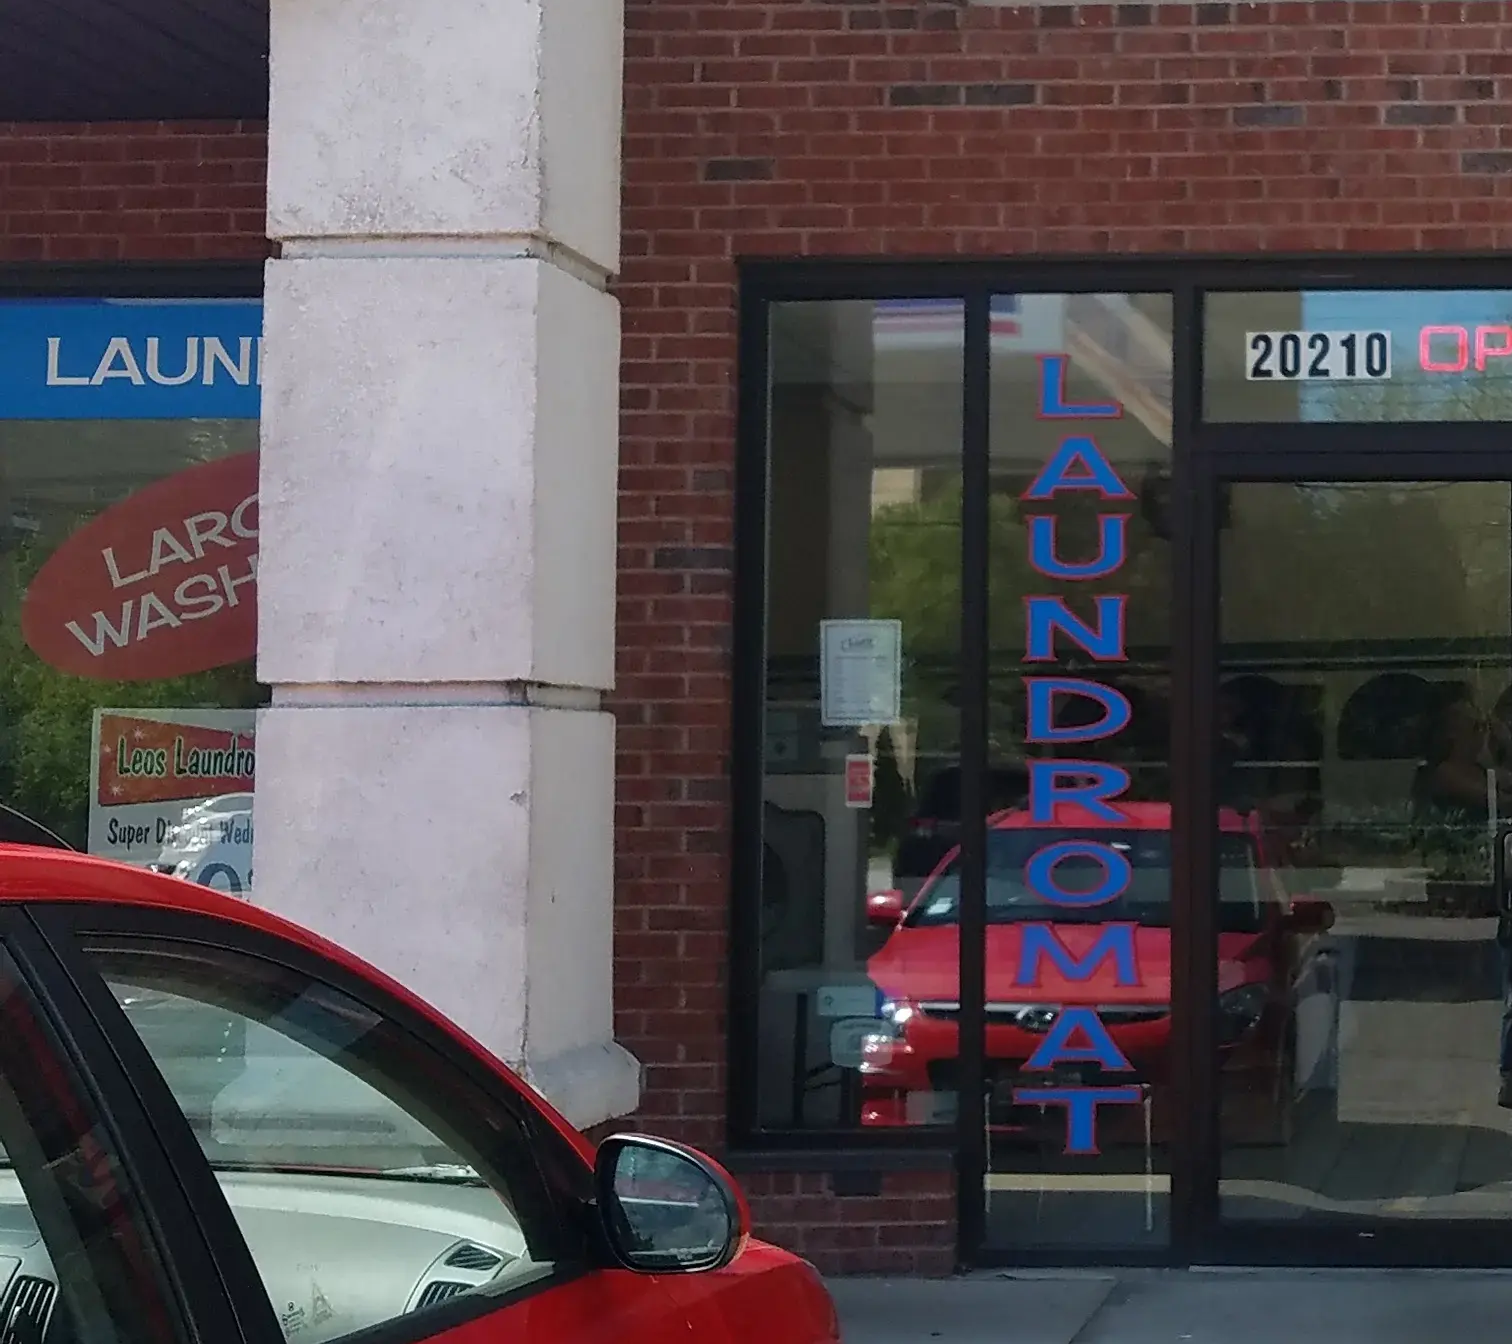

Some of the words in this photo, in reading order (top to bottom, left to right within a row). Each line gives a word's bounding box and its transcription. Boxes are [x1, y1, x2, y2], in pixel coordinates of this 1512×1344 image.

[45, 336, 262, 386] LAUN
[1249, 331, 1388, 378] 20210
[118, 737, 165, 776] Leos
[1013, 354, 1143, 1156] LAUNDROMAT
[108, 818, 150, 849] Super
